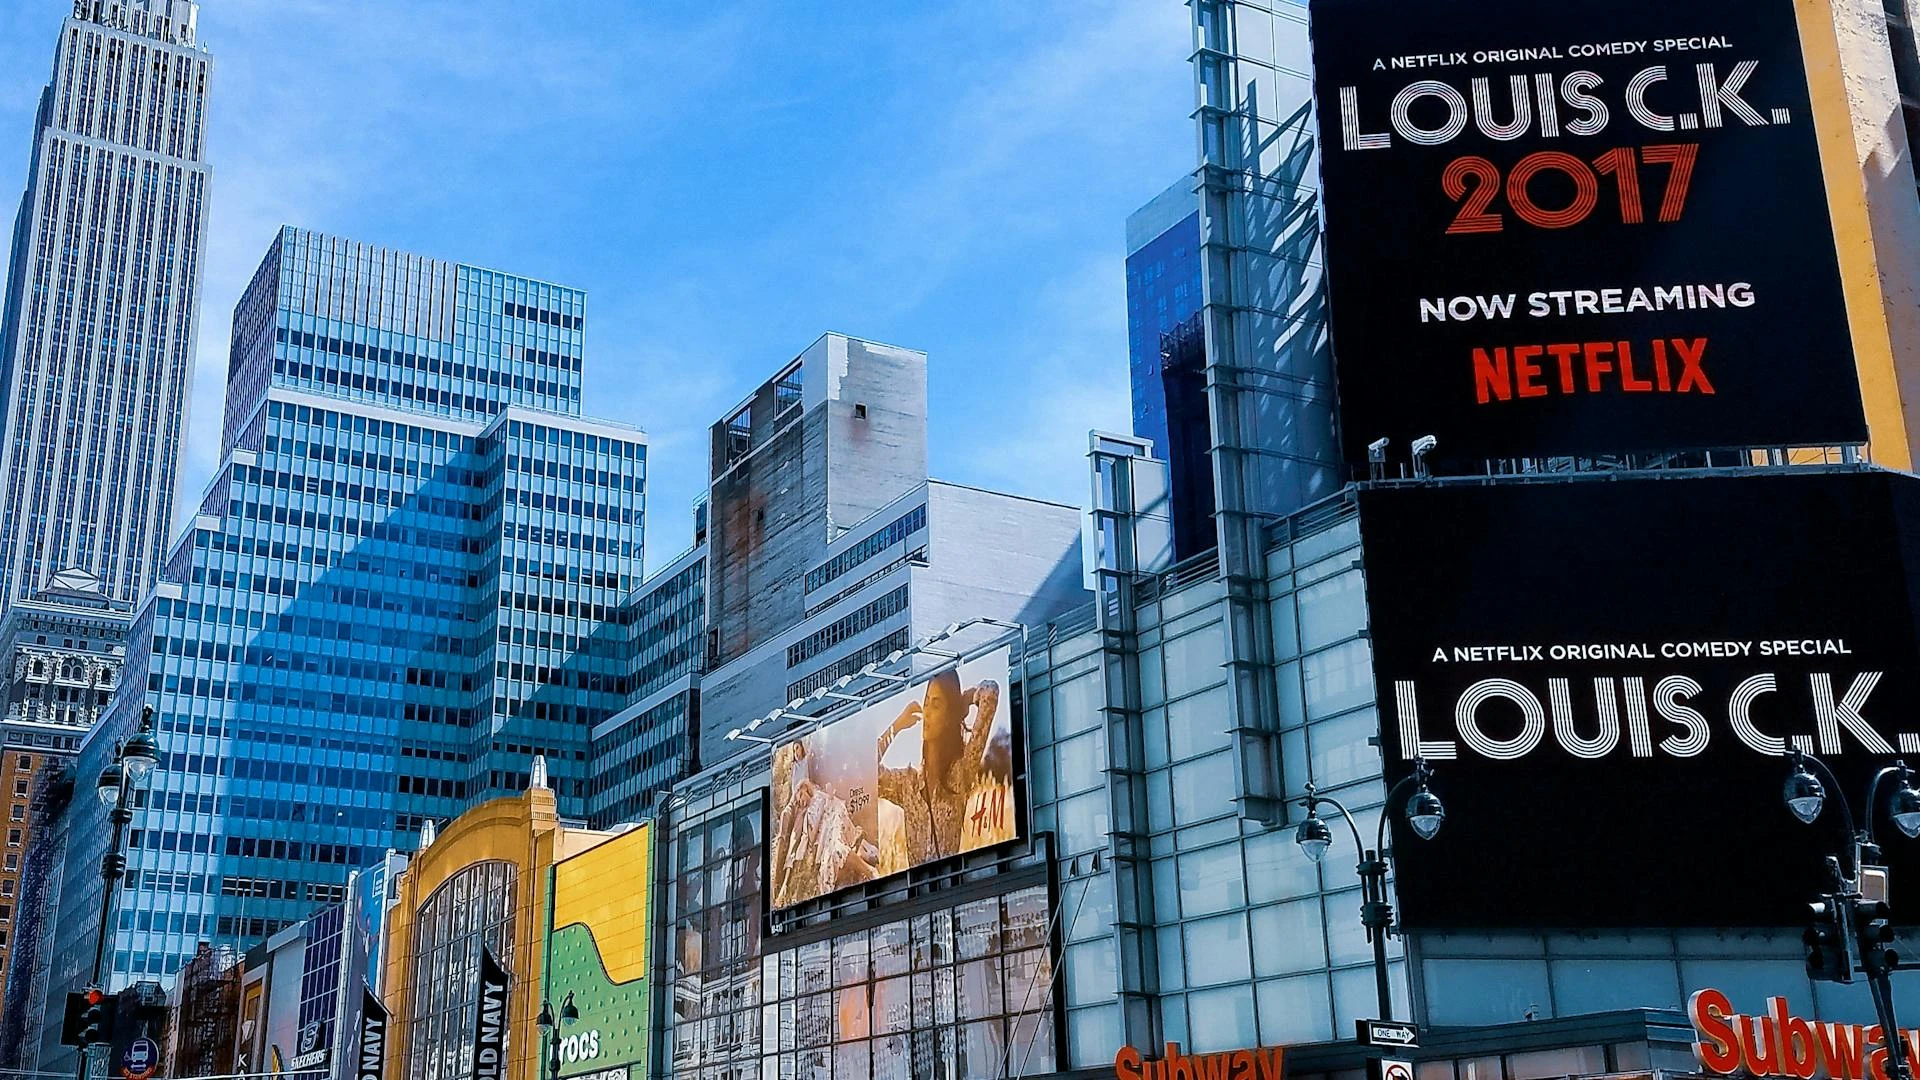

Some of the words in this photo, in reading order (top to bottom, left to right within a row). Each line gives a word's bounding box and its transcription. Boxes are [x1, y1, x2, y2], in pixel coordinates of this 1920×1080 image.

[1372, 58, 1386, 70] A
[1391, 52, 1468, 69] NETFLIX
[1473, 46, 1564, 63] ORIGINAL
[1568, 40, 1648, 57] COMEDY
[1653, 35, 1733, 52] SPECIAL
[1340, 70, 1610, 151] LOUIS
[1625, 59, 1791, 131] C.K.
[1441, 143, 1699, 234] 2017
[1419, 294, 1517, 323] NOW
[1527, 282, 1756, 318] STREAMING
[1472, 337, 1716, 404] NETFLIX
[1432, 647, 1449, 663] A
[1453, 645, 1544, 662] NETFLIX
[1549, 643, 1656, 660] ORIGINAL
[1660, 641, 1753, 658] COMEDY
[1759, 639, 1852, 656] SPECIAL
[1395, 675, 1711, 760] LOUIS
[1728, 671, 1920, 756] C.K.
[970, 784, 1006, 838] H&M
[482, 980, 504, 1043] NAVY
[1378, 1029, 1391, 1038] ONE
[1396, 1031, 1410, 1040] WAY
[362, 1018, 383, 1071] NAVY
[550, 1029, 600, 1064] rocs
